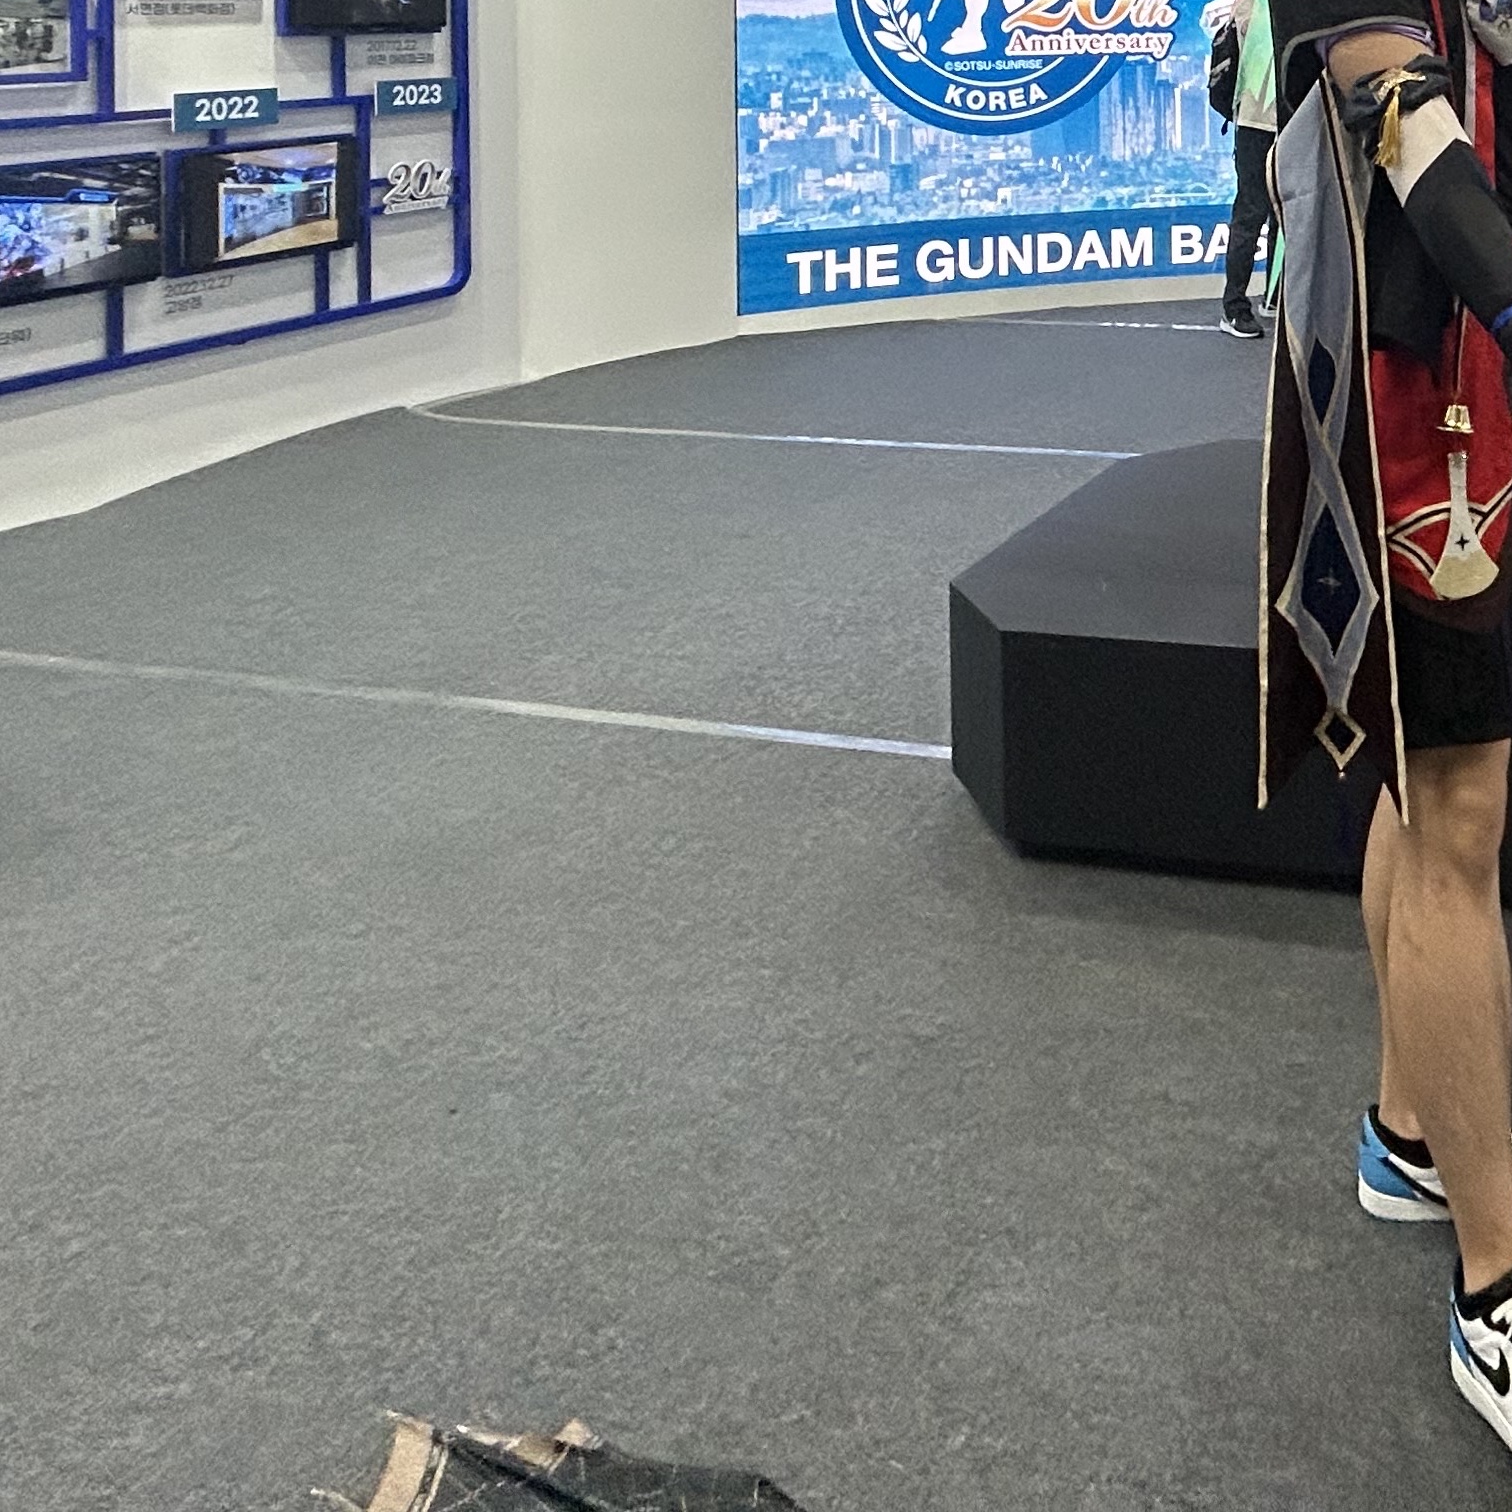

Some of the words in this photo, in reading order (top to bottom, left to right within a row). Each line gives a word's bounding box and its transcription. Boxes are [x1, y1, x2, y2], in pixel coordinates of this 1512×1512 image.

[1010, 32, 1170, 55] Anniversary
[195, 95, 259, 122] 2022
[392, 84, 442, 106] 2023
[945, 83, 1048, 111] KOREA
[787, 243, 899, 295] THE
[915, 227, 1153, 283] GUNDAM
